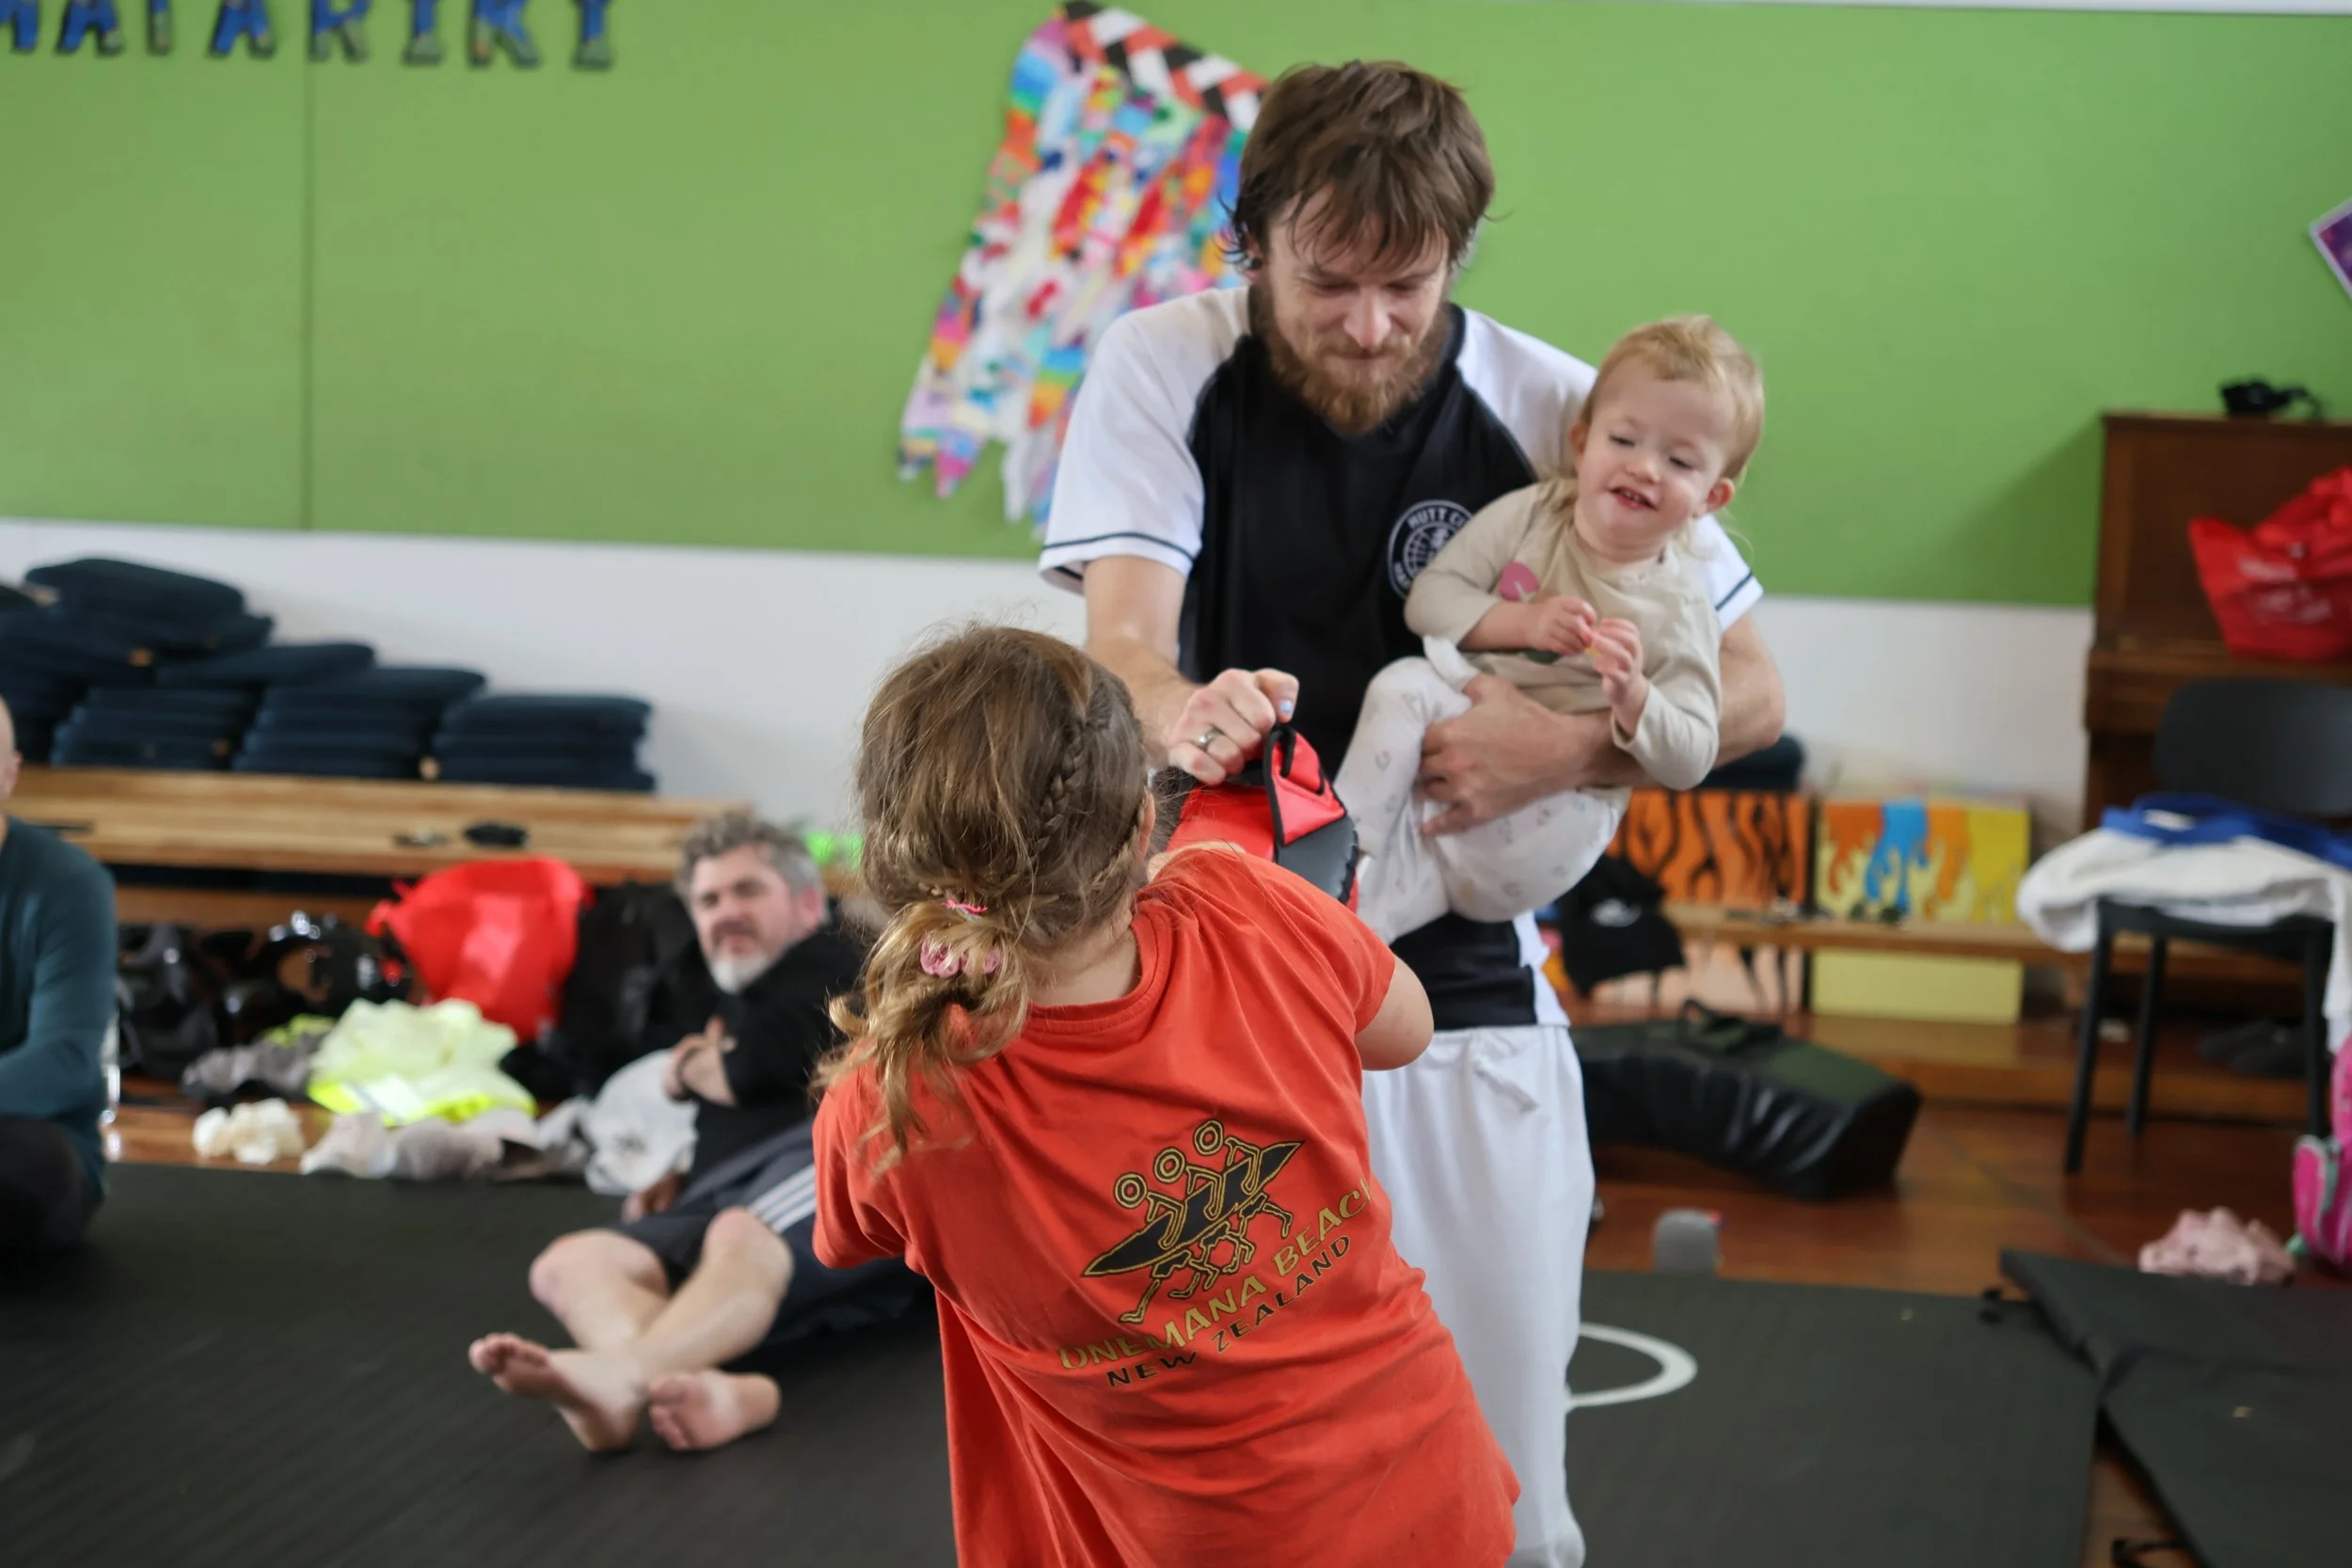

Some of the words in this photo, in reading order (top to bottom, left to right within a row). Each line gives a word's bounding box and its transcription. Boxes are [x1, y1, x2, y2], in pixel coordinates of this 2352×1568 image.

[1059, 1275, 1267, 1370] ONEMANA
[1105, 1351, 1198, 1387] NEW
[1210, 1235, 1351, 1353] ZEALAND
